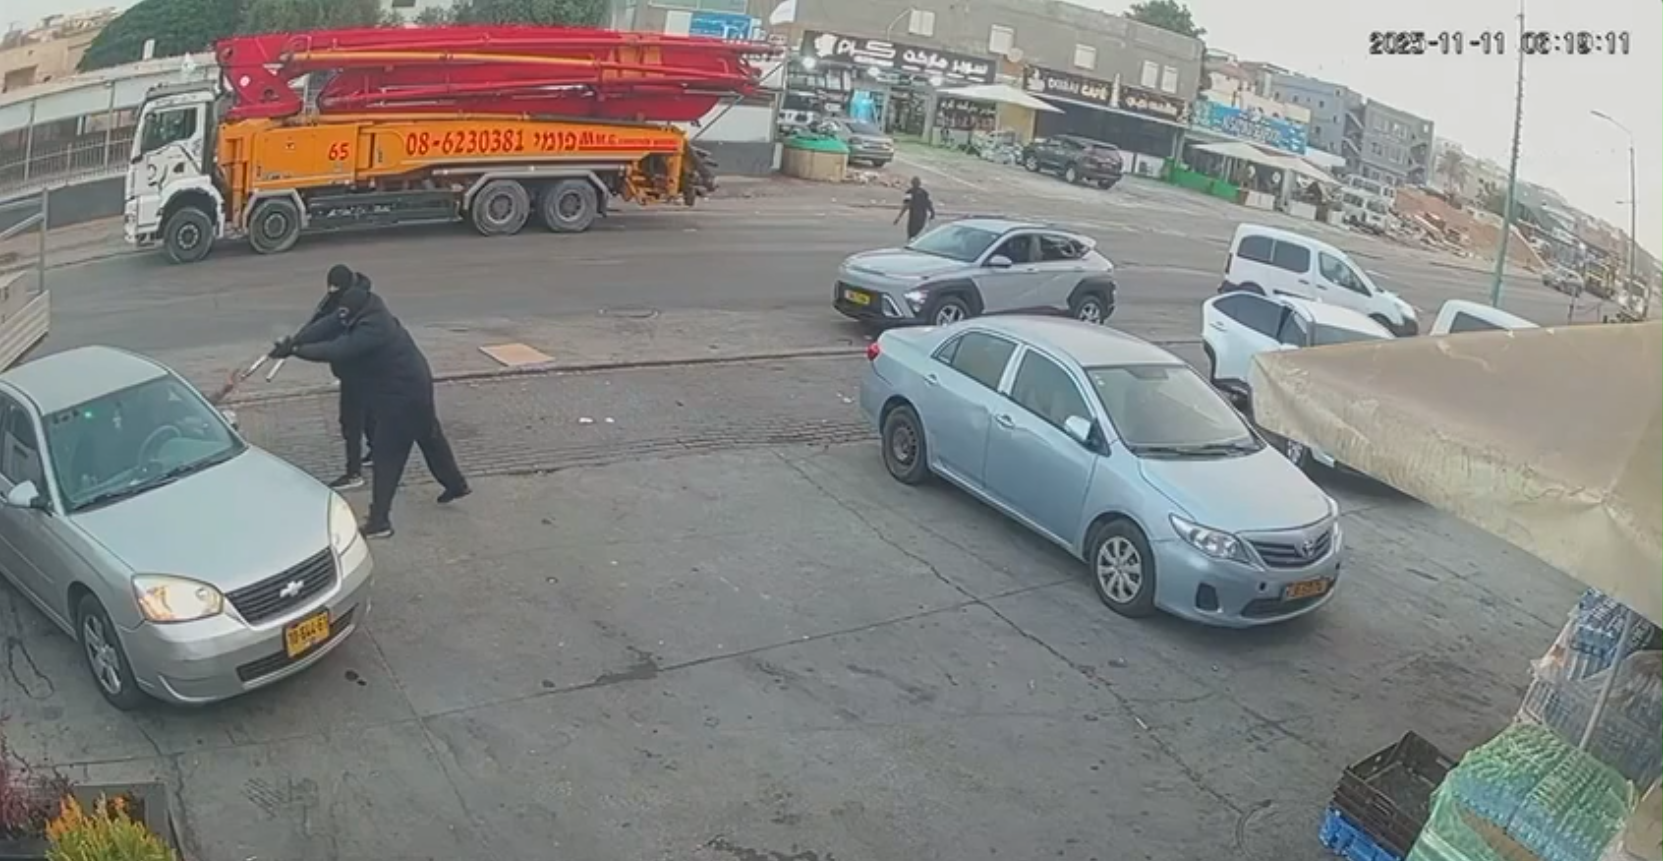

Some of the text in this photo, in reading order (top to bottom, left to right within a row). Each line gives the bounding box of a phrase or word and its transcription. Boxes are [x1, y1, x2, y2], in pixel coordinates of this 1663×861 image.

[838, 39, 896, 59] كرم
[329, 141, 349, 160] 65
[406, 129, 524, 155] 08-6230381
[533, 131, 577, 151] פומי
